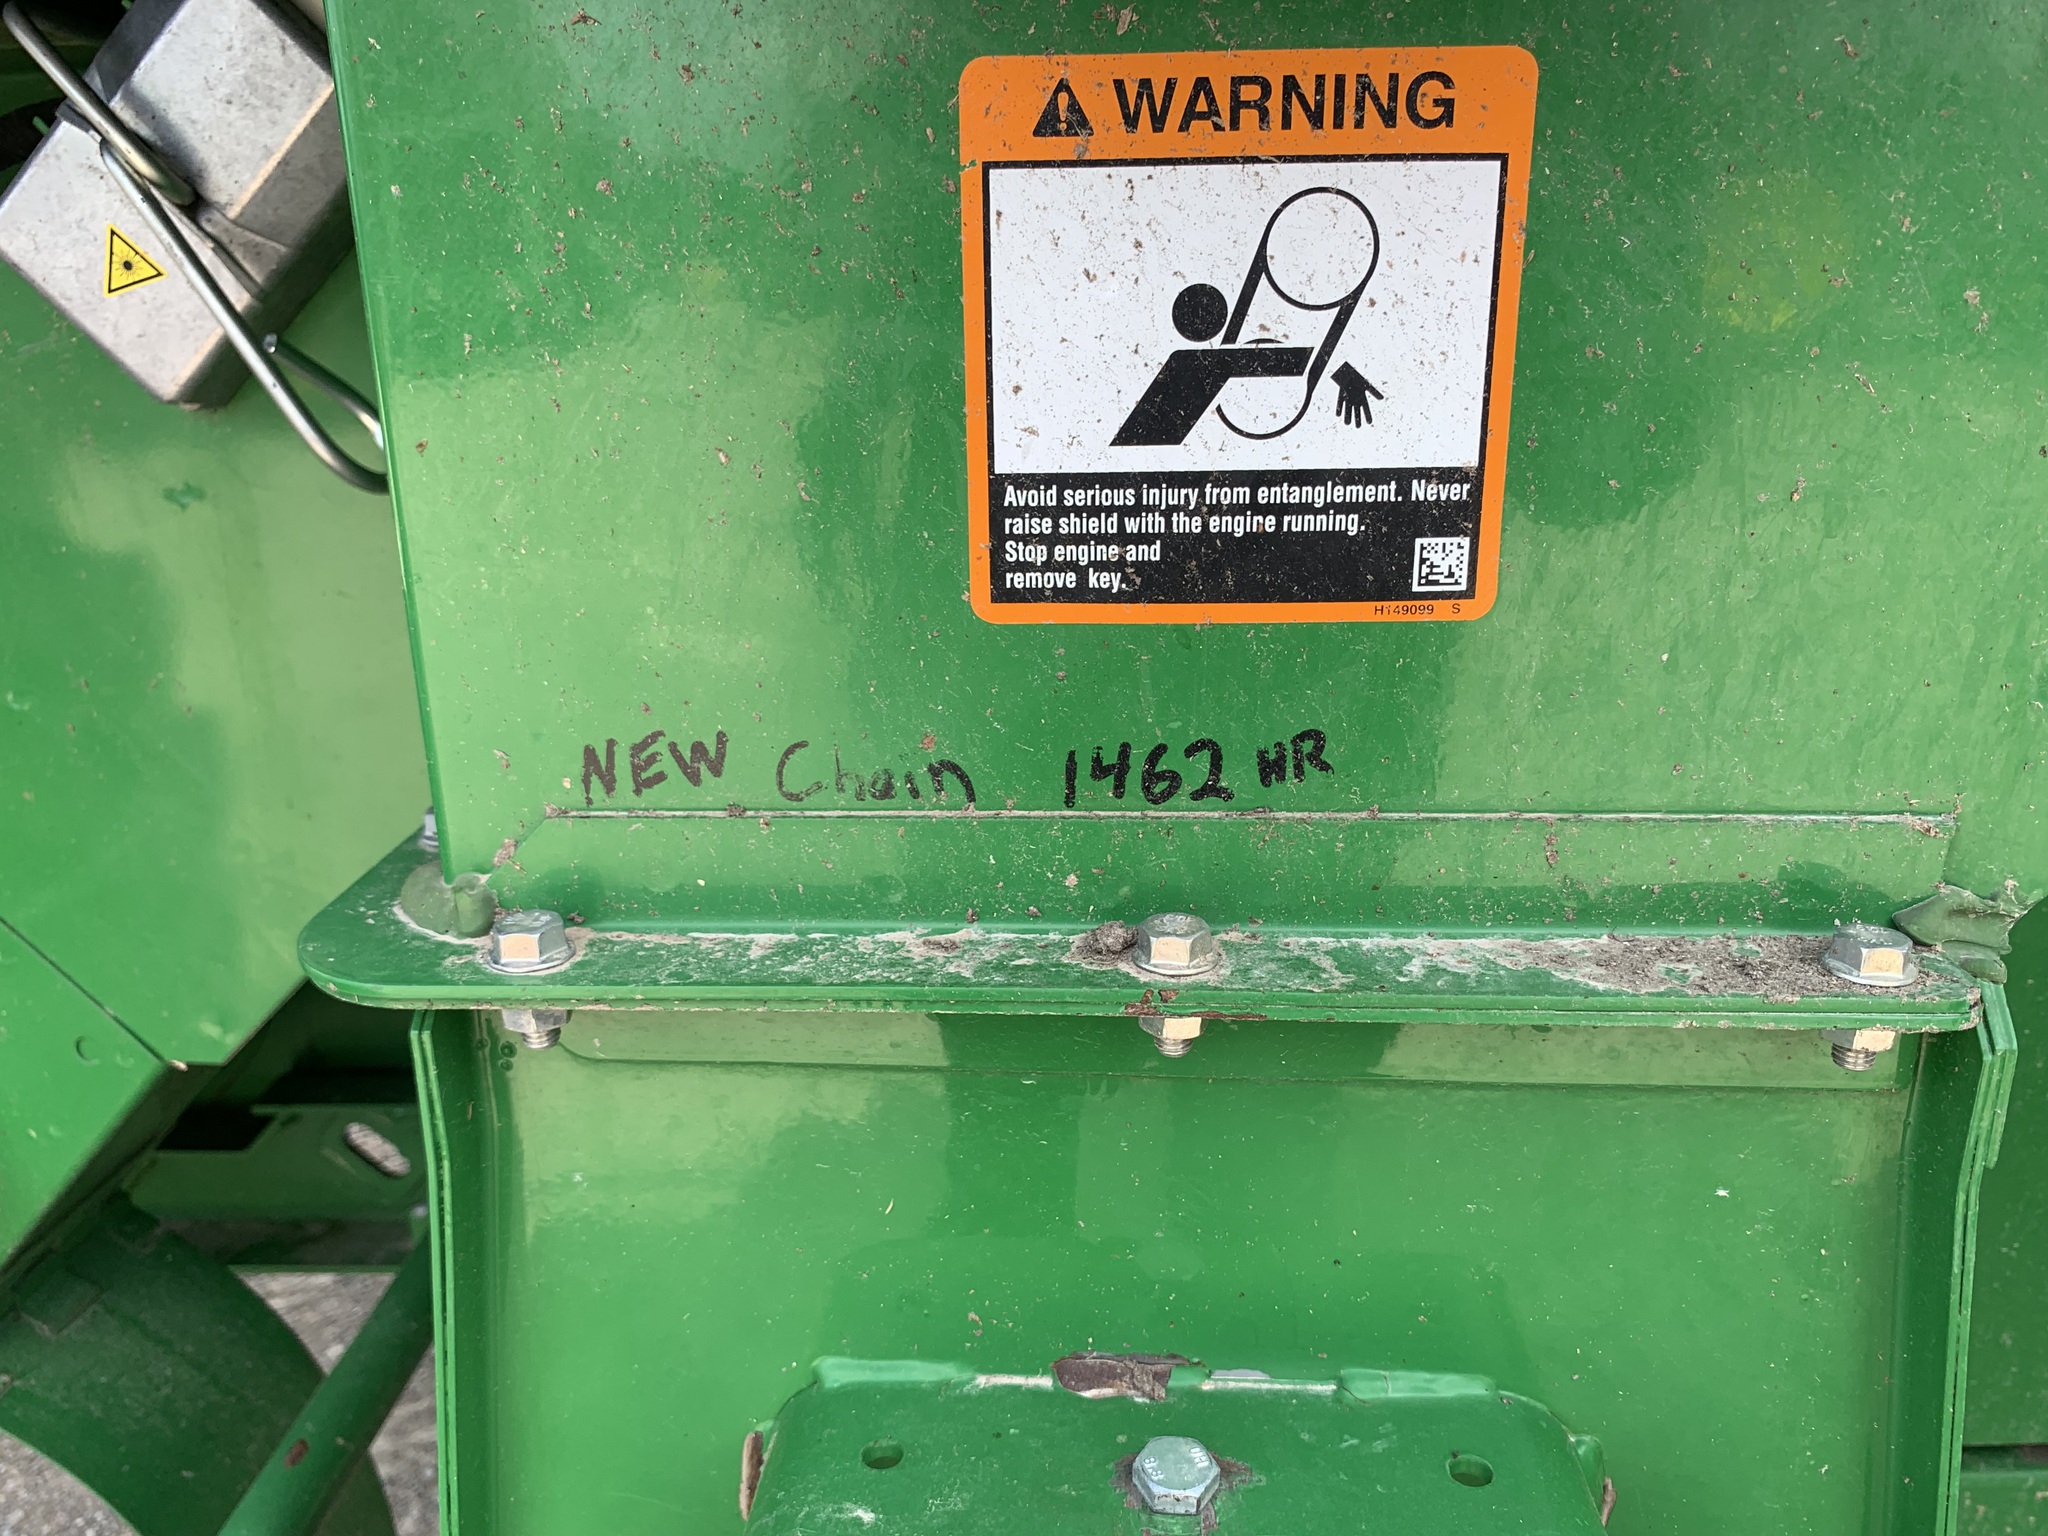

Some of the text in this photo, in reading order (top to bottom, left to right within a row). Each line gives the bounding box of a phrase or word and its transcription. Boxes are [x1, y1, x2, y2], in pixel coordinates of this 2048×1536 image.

[1113, 70, 1456, 134] WARNING
[1003, 479, 1471, 510] Avoid serious injury from entanglement. Never
[1004, 509, 1366, 538] raise shield with the engine running.
[1004, 540, 1161, 566] Stop engine and
[1005, 567, 1127, 594] remove key.
[1451, 602, 1461, 615] S
[581, 728, 1335, 808] NEW Chain 1462 HR
